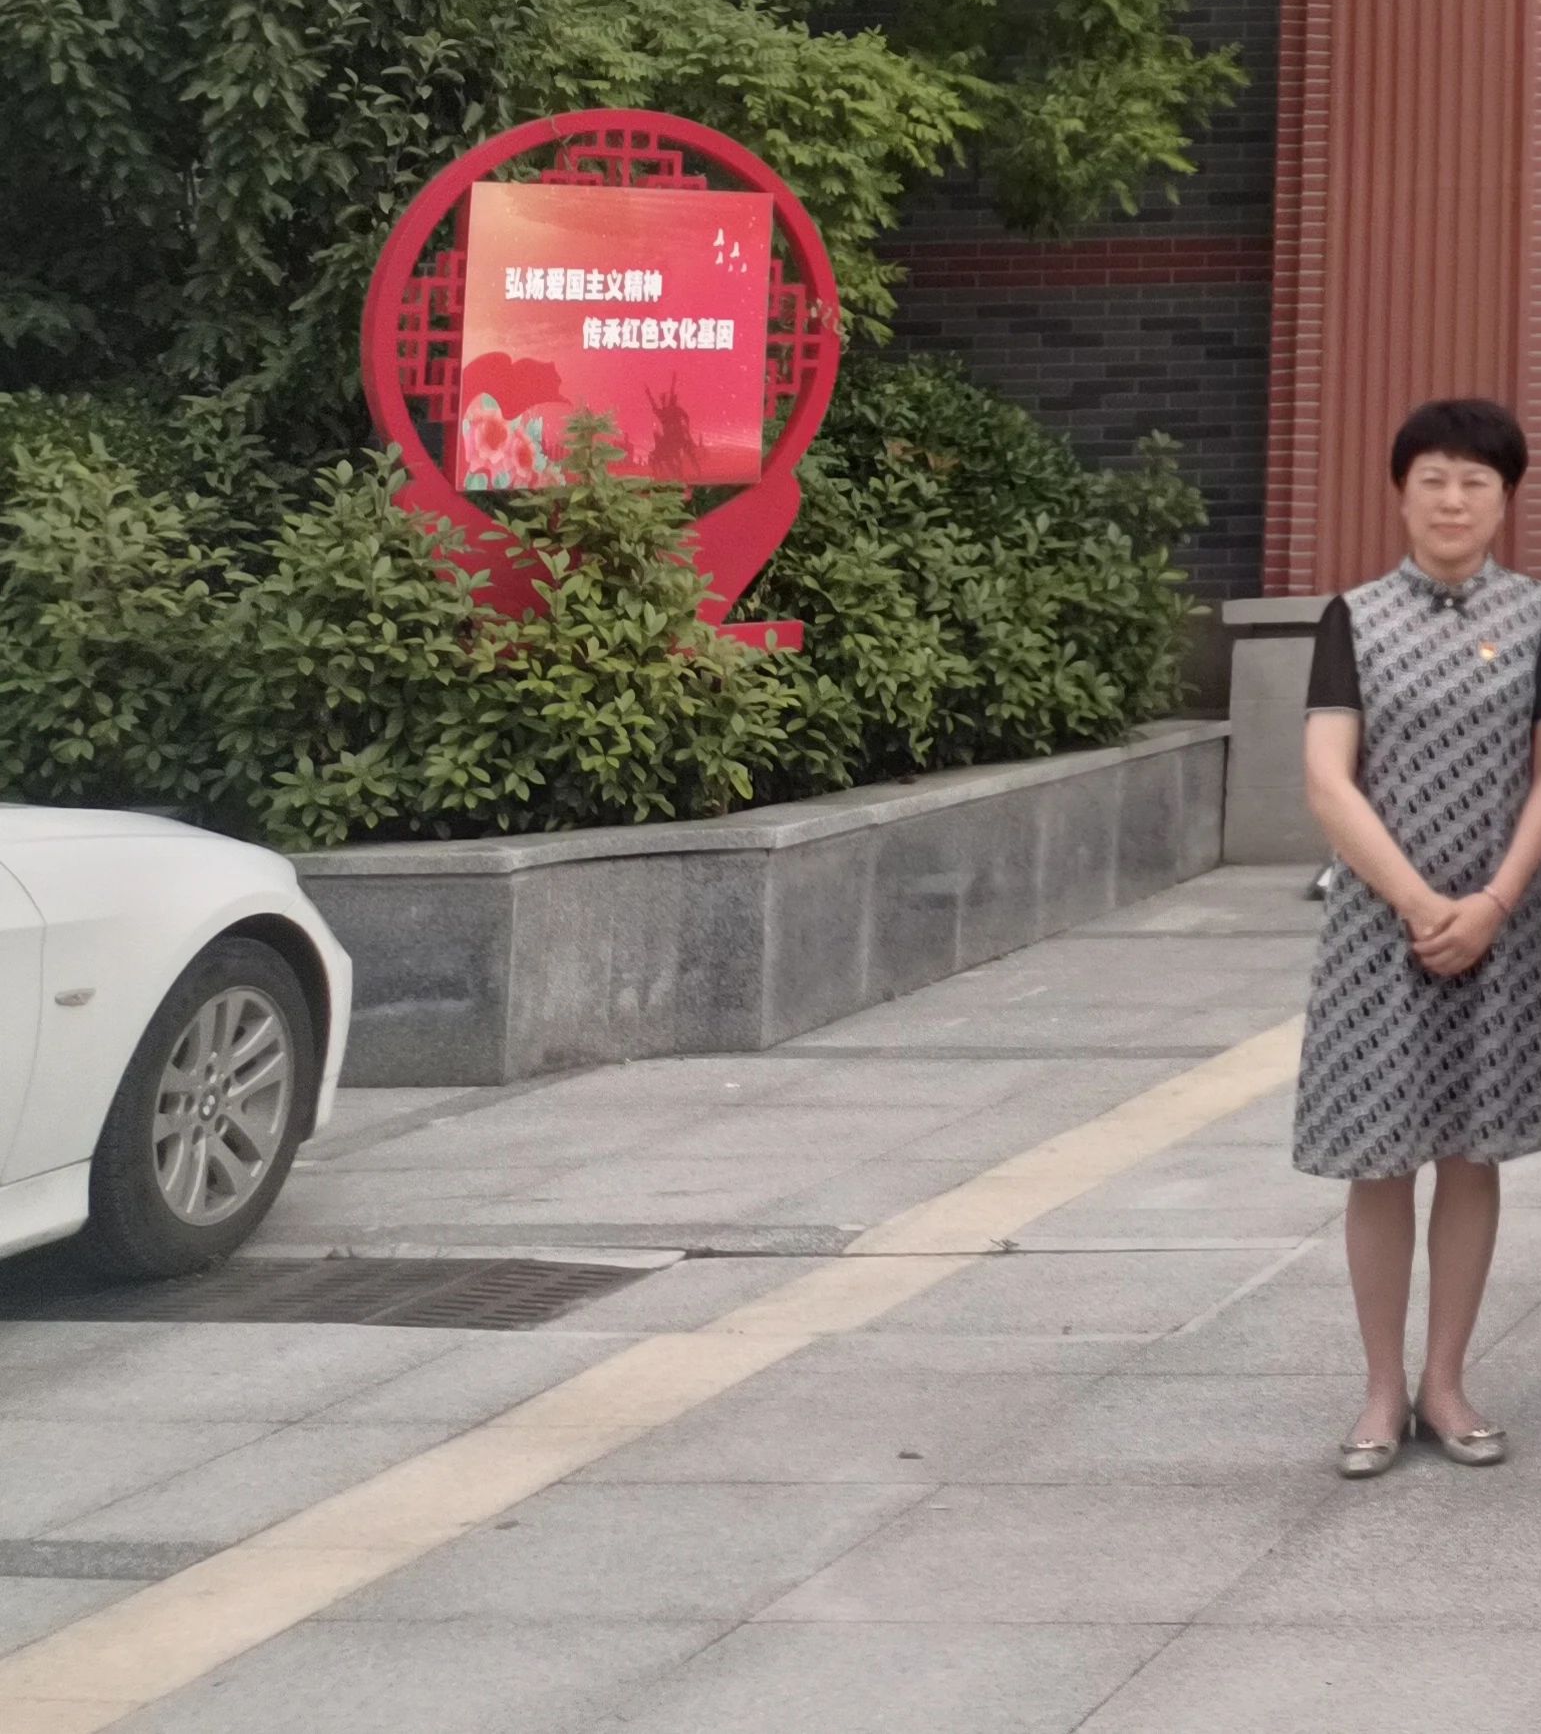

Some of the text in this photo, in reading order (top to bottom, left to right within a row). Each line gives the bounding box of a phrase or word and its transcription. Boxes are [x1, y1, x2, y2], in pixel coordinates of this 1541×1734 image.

[505, 267, 662, 302] 弘扬爱国主义精神
[582, 316, 734, 350] 传承红色文化基因
